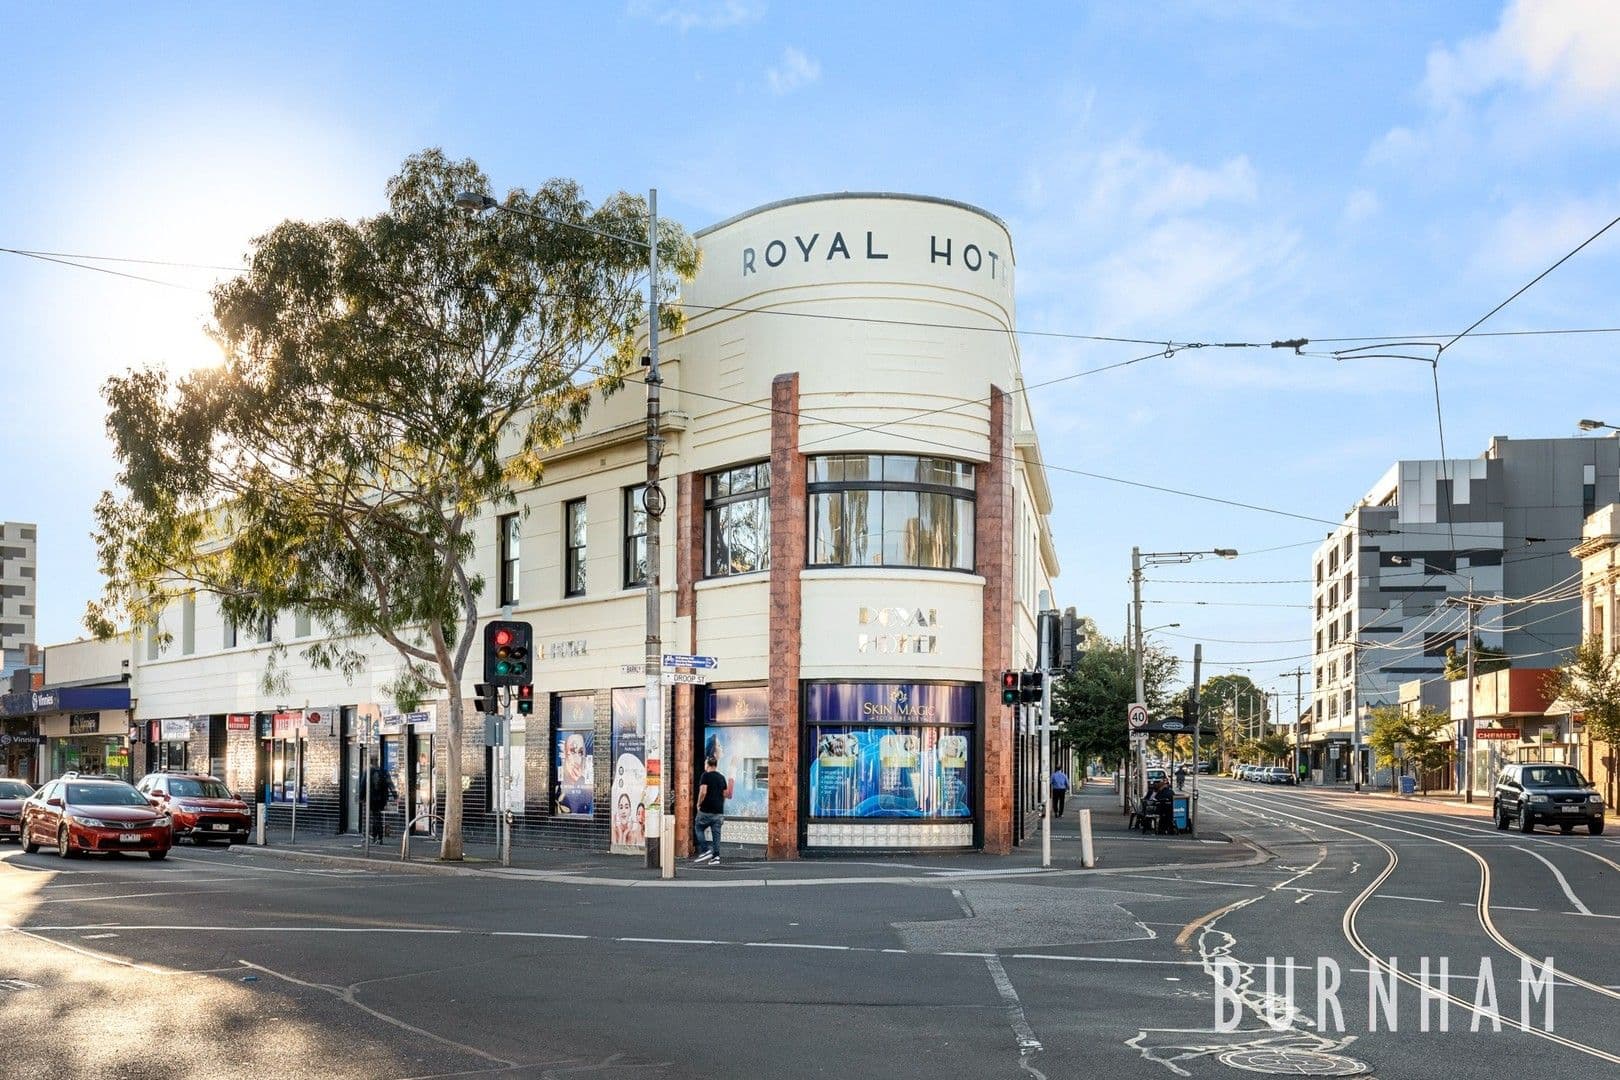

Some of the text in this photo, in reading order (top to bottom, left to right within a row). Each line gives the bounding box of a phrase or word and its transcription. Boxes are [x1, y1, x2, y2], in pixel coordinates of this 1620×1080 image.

[743, 231, 1006, 283] ROYAL HOT
[673, 673, 696, 682] DROOP
[863, 702, 936, 717] SKIN MAGIC
[1132, 712, 1145, 722] 40
[12, 736, 41, 744] Vinnies
